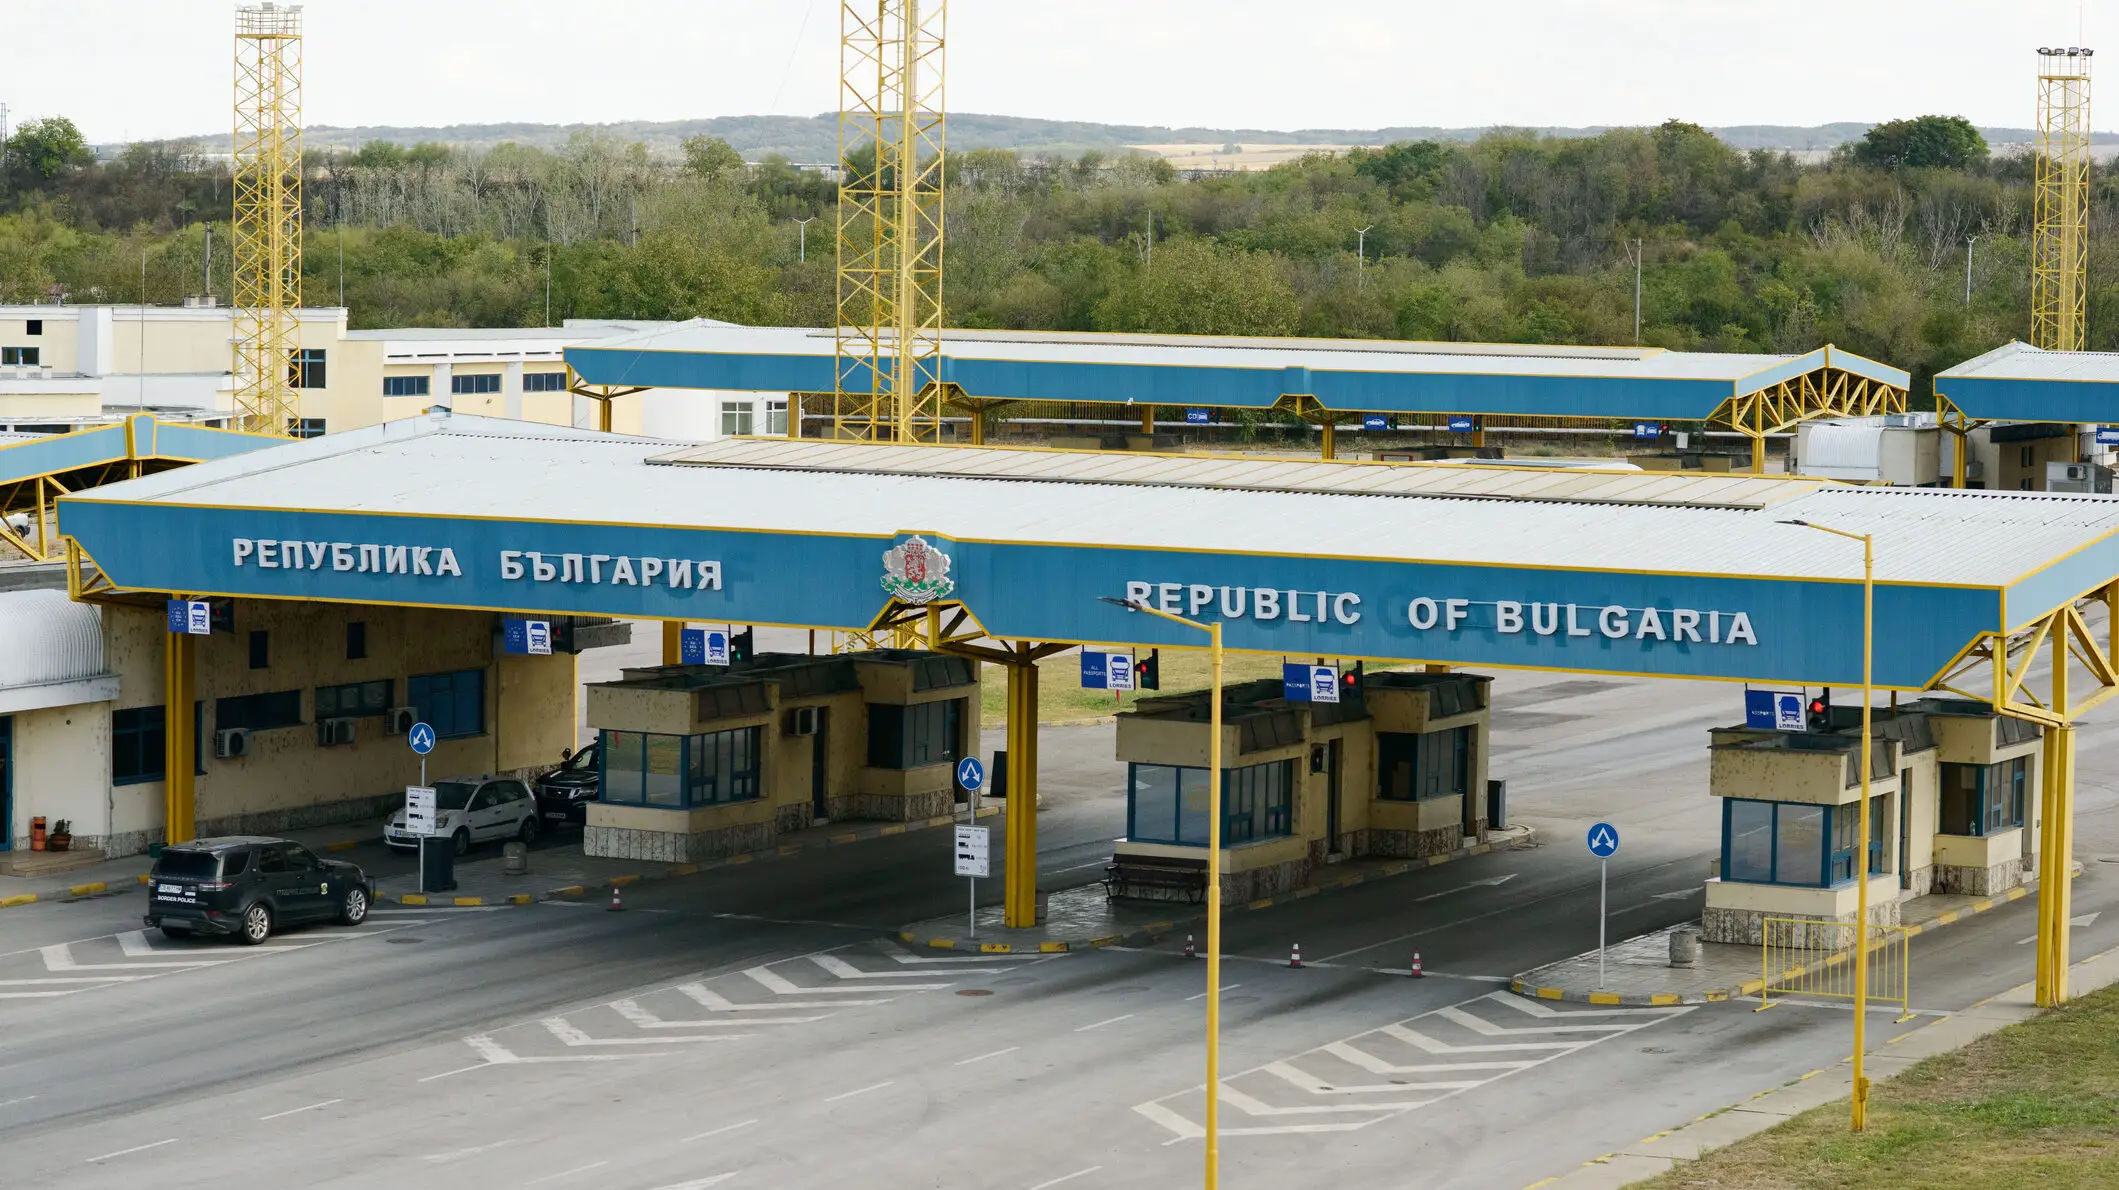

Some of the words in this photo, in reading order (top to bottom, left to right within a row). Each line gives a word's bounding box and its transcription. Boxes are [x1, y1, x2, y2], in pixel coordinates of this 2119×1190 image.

[233, 538, 462, 577] РЕПУБЛИКА
[500, 550, 722, 591] БЪЛГАРИЯ
[1127, 580, 1361, 625] REPUBLIC
[1408, 597, 1469, 630] OF
[1496, 600, 1758, 646] BULGARIA
